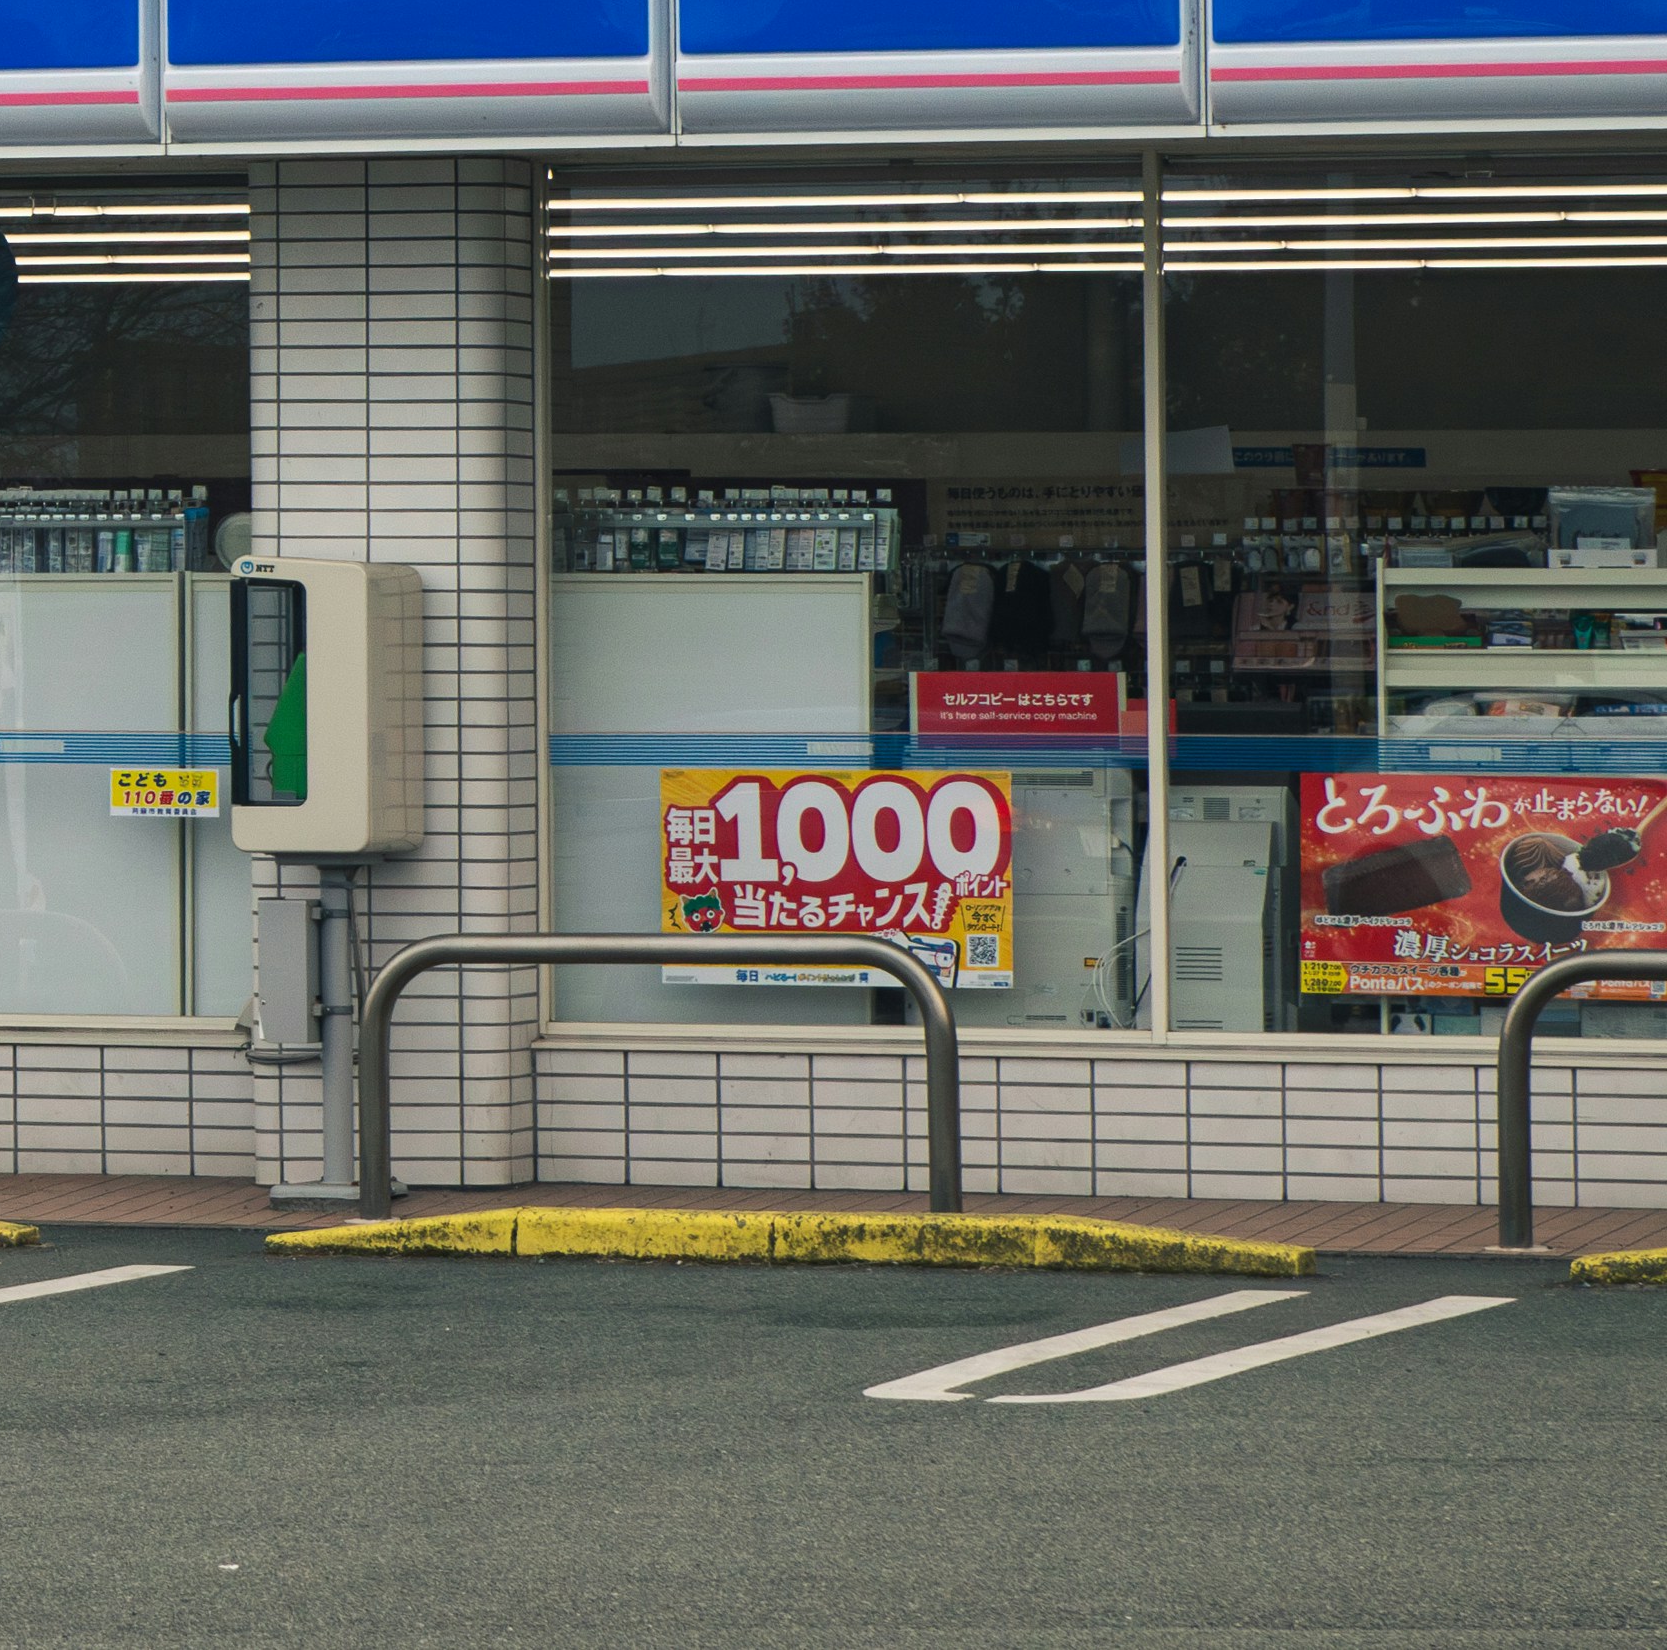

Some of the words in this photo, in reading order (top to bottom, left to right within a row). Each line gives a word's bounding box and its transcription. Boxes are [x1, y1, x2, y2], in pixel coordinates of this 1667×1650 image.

[256, 564, 275, 573] NTT
[943, 692, 1094, 707] セルフコピーはこちらです
[956, 711, 977, 720] here
[979, 711, 1031, 720] self-service
[1034, 712, 1056, 722] copy
[1058, 711, 1097, 720] machine
[118, 772, 167, 787] こども
[124, 790, 211, 806] 110番の家
[1513, 787, 1649, 821] が止まらない!
[667, 807, 716, 845] 毎日
[715, 780, 1001, 886] 1,000
[668, 847, 719, 884] 最大
[955, 871, 1008, 897] ポイント
[733, 881, 953, 930] 当たるチャンス!
[971, 911, 996, 922] 今すぐ
[1393, 929, 1588, 962] 濃厚ショコラスイーツ
[1350, 975, 1425, 991] Pontaパス
